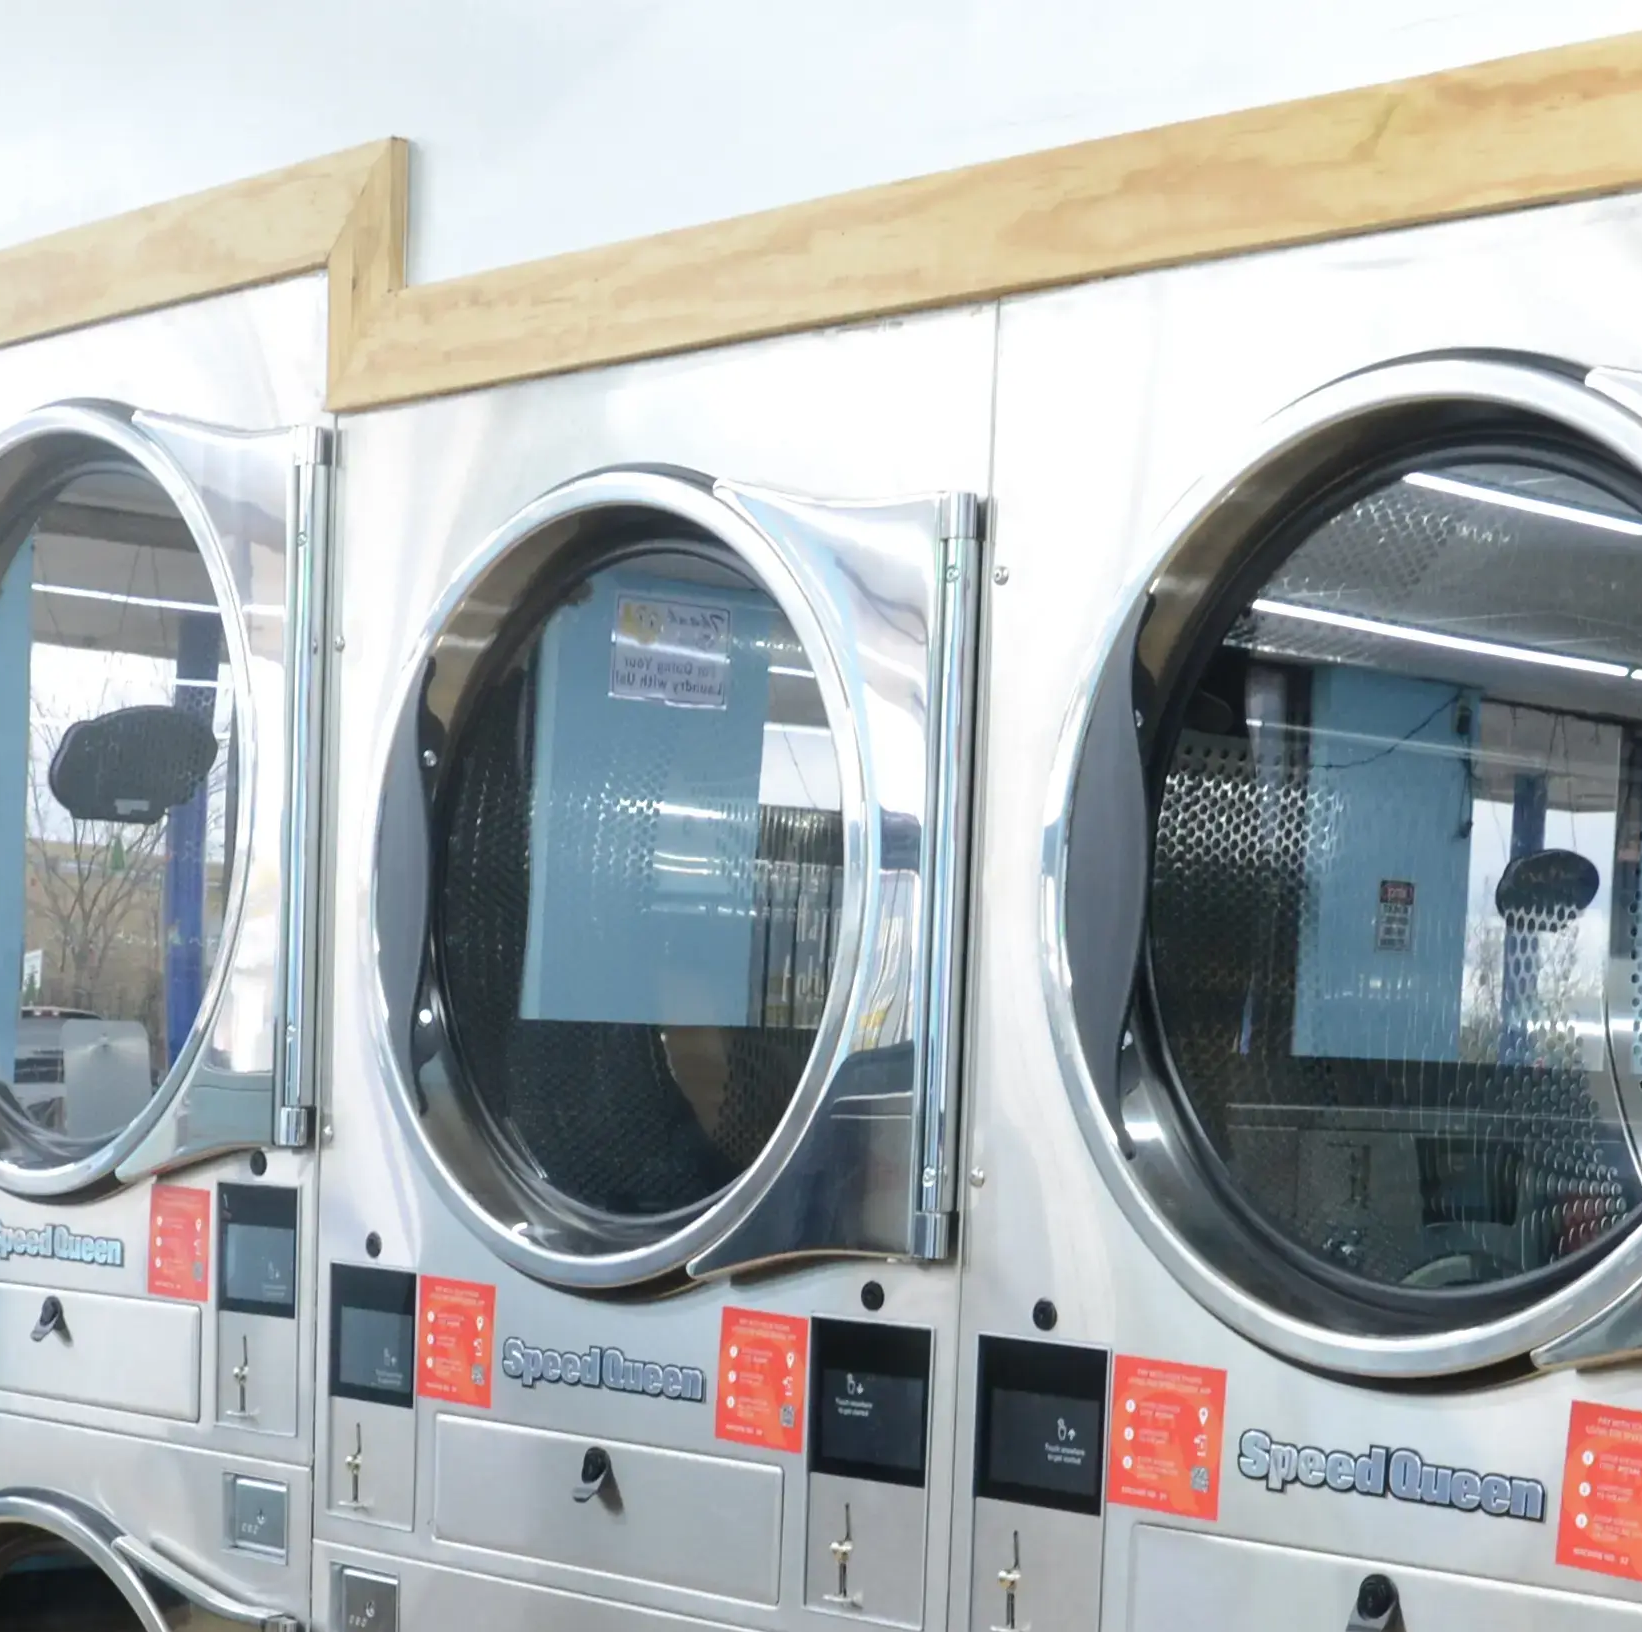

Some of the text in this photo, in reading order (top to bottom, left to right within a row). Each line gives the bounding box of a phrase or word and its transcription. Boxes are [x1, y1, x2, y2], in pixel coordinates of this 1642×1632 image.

[54, 1225, 124, 1267] Queen
[503, 1337, 603, 1388] Speed
[603, 1347, 706, 1403] Queen
[1238, 1429, 1391, 1493] Speed
[1389, 1447, 1547, 1522] Queen
